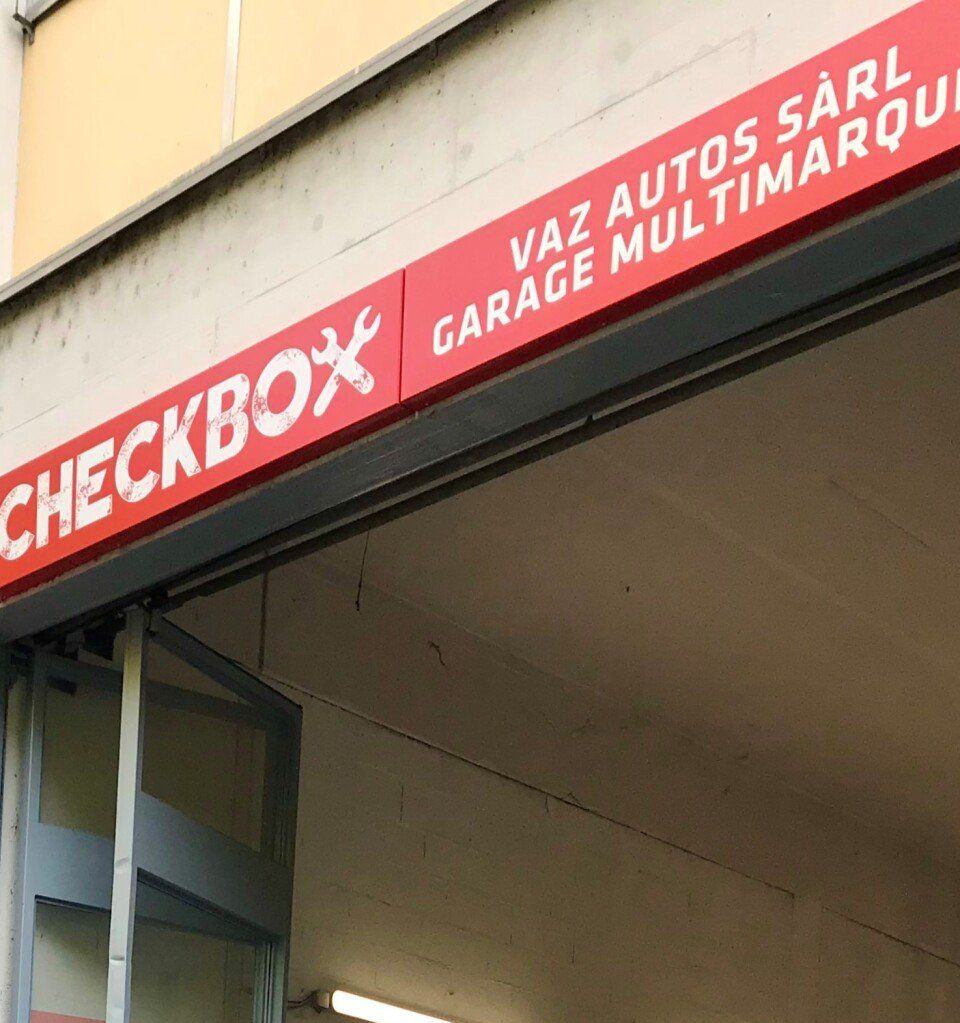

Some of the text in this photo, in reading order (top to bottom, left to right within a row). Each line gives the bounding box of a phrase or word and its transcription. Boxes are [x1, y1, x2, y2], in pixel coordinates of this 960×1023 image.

[509, 45, 913, 272] VAZ AUTOS SÀRL
[432, 246, 594, 357] GARAGE
